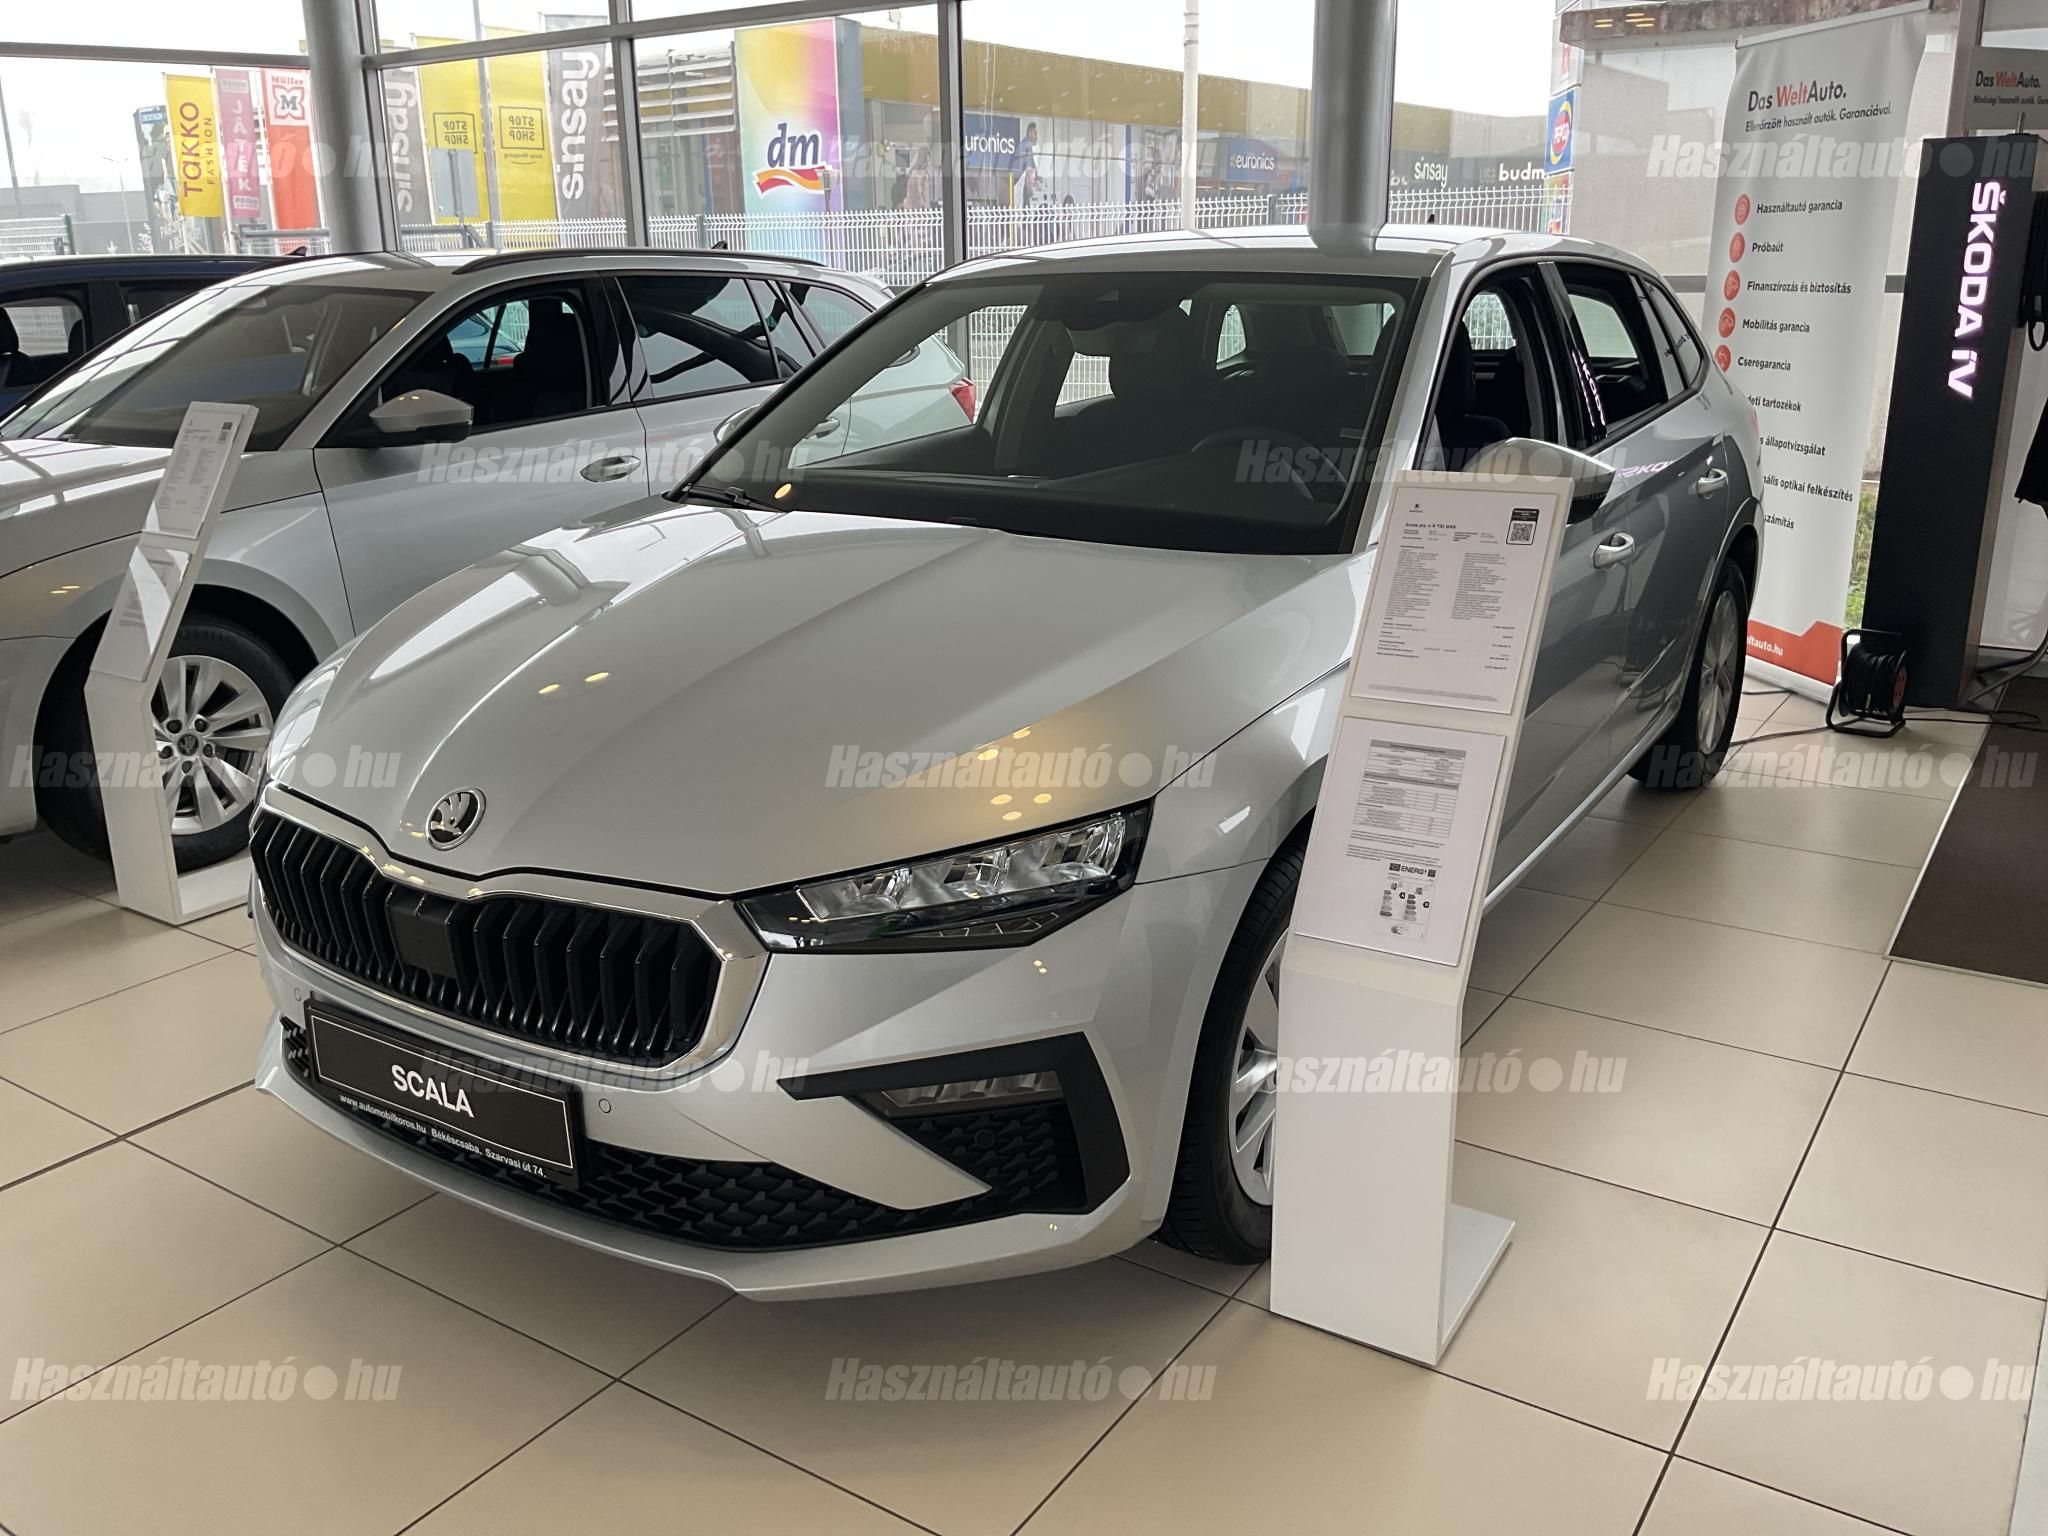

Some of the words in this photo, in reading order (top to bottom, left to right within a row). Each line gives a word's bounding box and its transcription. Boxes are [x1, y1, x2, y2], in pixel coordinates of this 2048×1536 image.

[271, 75, 304, 86] Müller
[1976, 70, 1994, 87] Das
[280, 94, 297, 111] M
[1747, 90, 1773, 112] Das
[1776, 80, 1847, 108] WeltAuto.
[556, 51, 600, 200] sinsay
[1784, 112, 1813, 128] használt
[1814, 109, 1837, 125] autók.
[202, 117, 216, 185] FASHION
[767, 122, 822, 168] dm
[964, 133, 1016, 156] uronics
[1234, 150, 1276, 172] euronics
[1414, 157, 1449, 188] sinsay
[1498, 162, 1547, 181] budm
[1756, 201, 1806, 214] Használtautó
[1808, 199, 1843, 213] garancia
[1751, 242, 1784, 254] Próbaút
[1954, 182, 2006, 338] ŠKODA
[1747, 280, 1798, 293] Finanszírozás
[1800, 282, 1809, 293] és
[1810, 282, 1852, 296] biztosítás
[1742, 319, 1777, 332] Mobilitás
[1779, 321, 1810, 334] garancia
[1738, 356, 1791, 372] Cseregarancia
[1762, 397, 1802, 413] tartozékok
[1765, 436, 1826, 457] állapotvizsgálat
[1780, 479, 1805, 493] optikai
[1806, 482, 1854, 503] felkészítés
[1747, 636, 1783, 656] ltauto.hu
[391, 1064, 475, 1119] SCALA
[485, 1148, 521, 1169] Szarvasi
[522, 1161, 532, 1173] út
[533, 1165, 547, 1178] 74.
